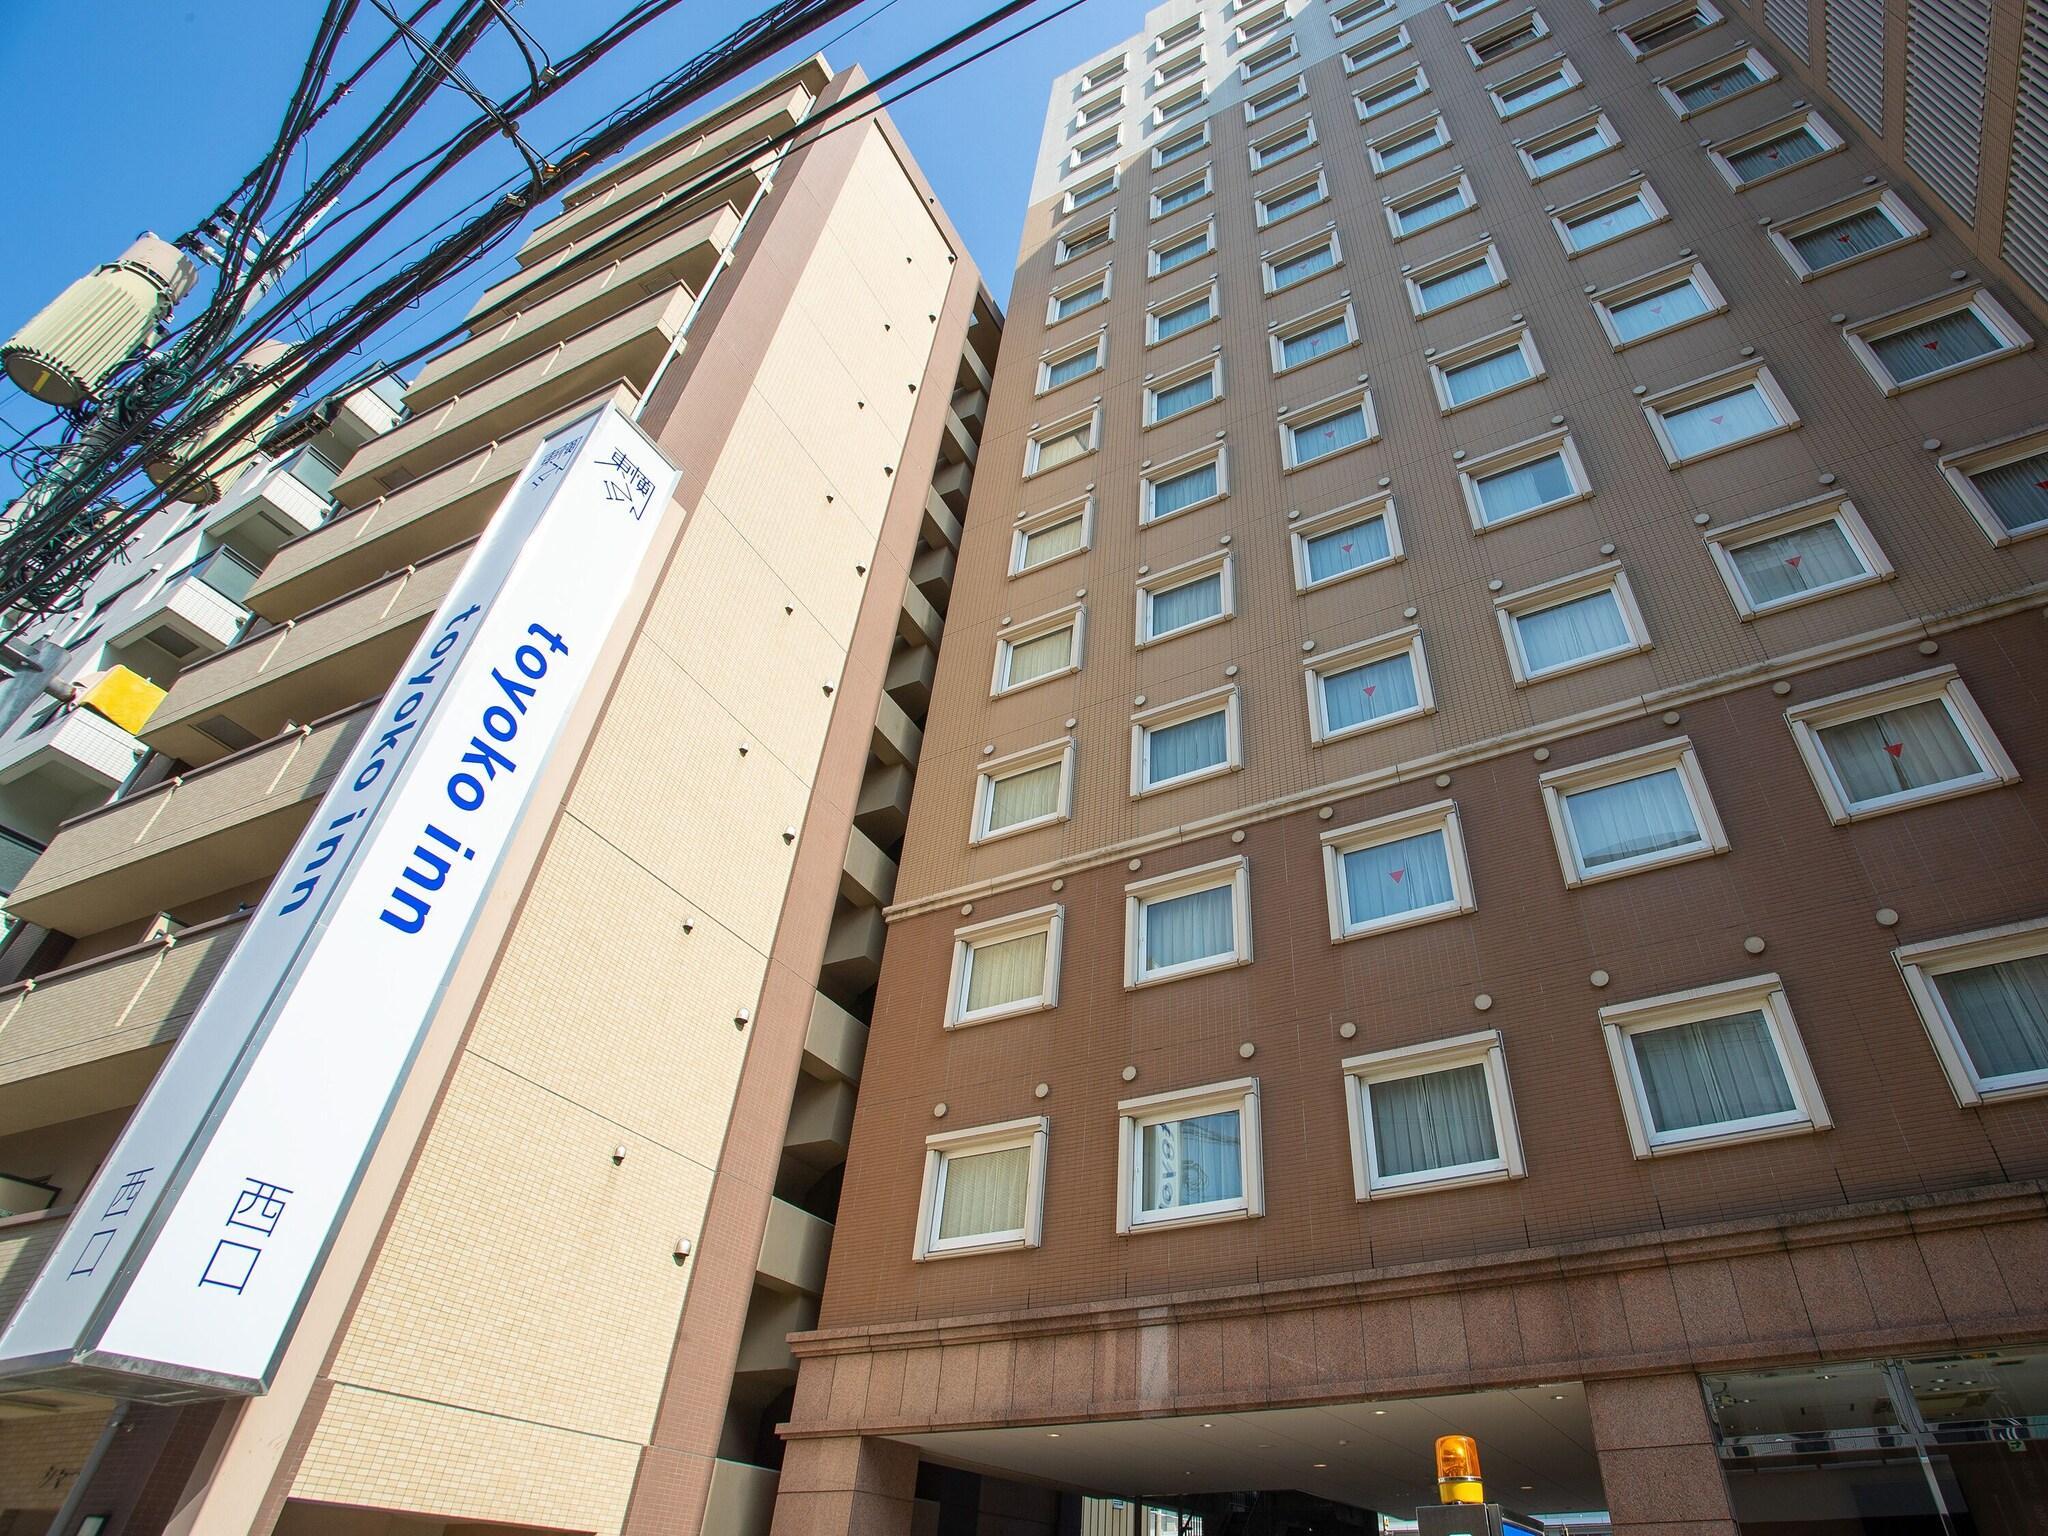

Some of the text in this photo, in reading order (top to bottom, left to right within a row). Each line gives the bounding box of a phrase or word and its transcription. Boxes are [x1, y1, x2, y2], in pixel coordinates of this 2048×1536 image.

[32, 369, 52, 393] 1
[278, 604, 481, 920] toyoko inn
[380, 624, 569, 935] toyoko inn
[66, 1167, 155, 1281] 西口
[198, 1177, 294, 1296] 西口
